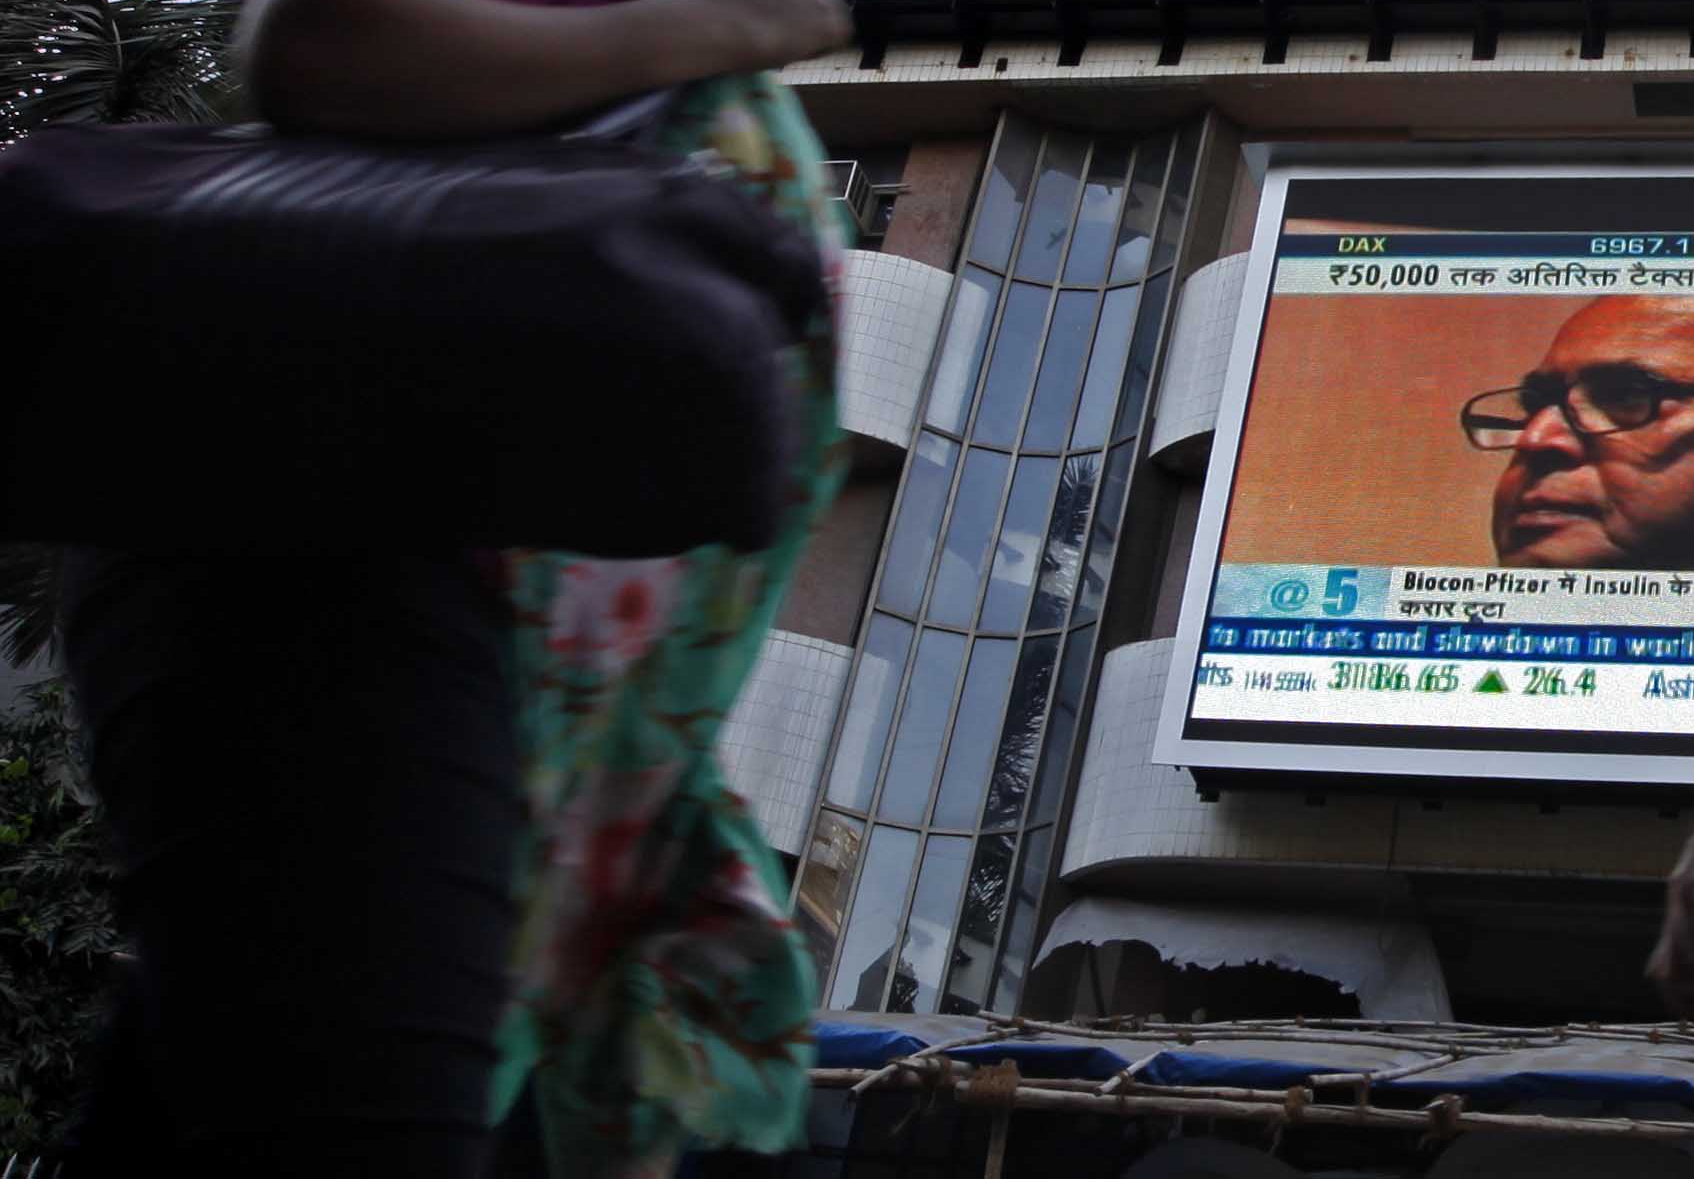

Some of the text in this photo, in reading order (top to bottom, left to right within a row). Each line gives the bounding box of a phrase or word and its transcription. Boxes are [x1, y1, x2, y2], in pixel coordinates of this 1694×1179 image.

[1338, 236, 1387, 253] DAX
[1449, 268, 1497, 287] तक
[1507, 261, 1619, 288] अतिरिक्त
[1628, 262, 1694, 287] टैक्स
[1321, 568, 1360, 616] 5
[1403, 571, 1550, 594] Biocon-Pfizer
[1557, 572, 1579, 594] में
[1584, 575, 1661, 596] Insulin
[1667, 575, 1693, 596] के
[1398, 600, 1458, 620] करार
[1370, 626, 1427, 653] and
[1433, 626, 1581, 655] slowdown
[1586, 630, 1619, 657] in
